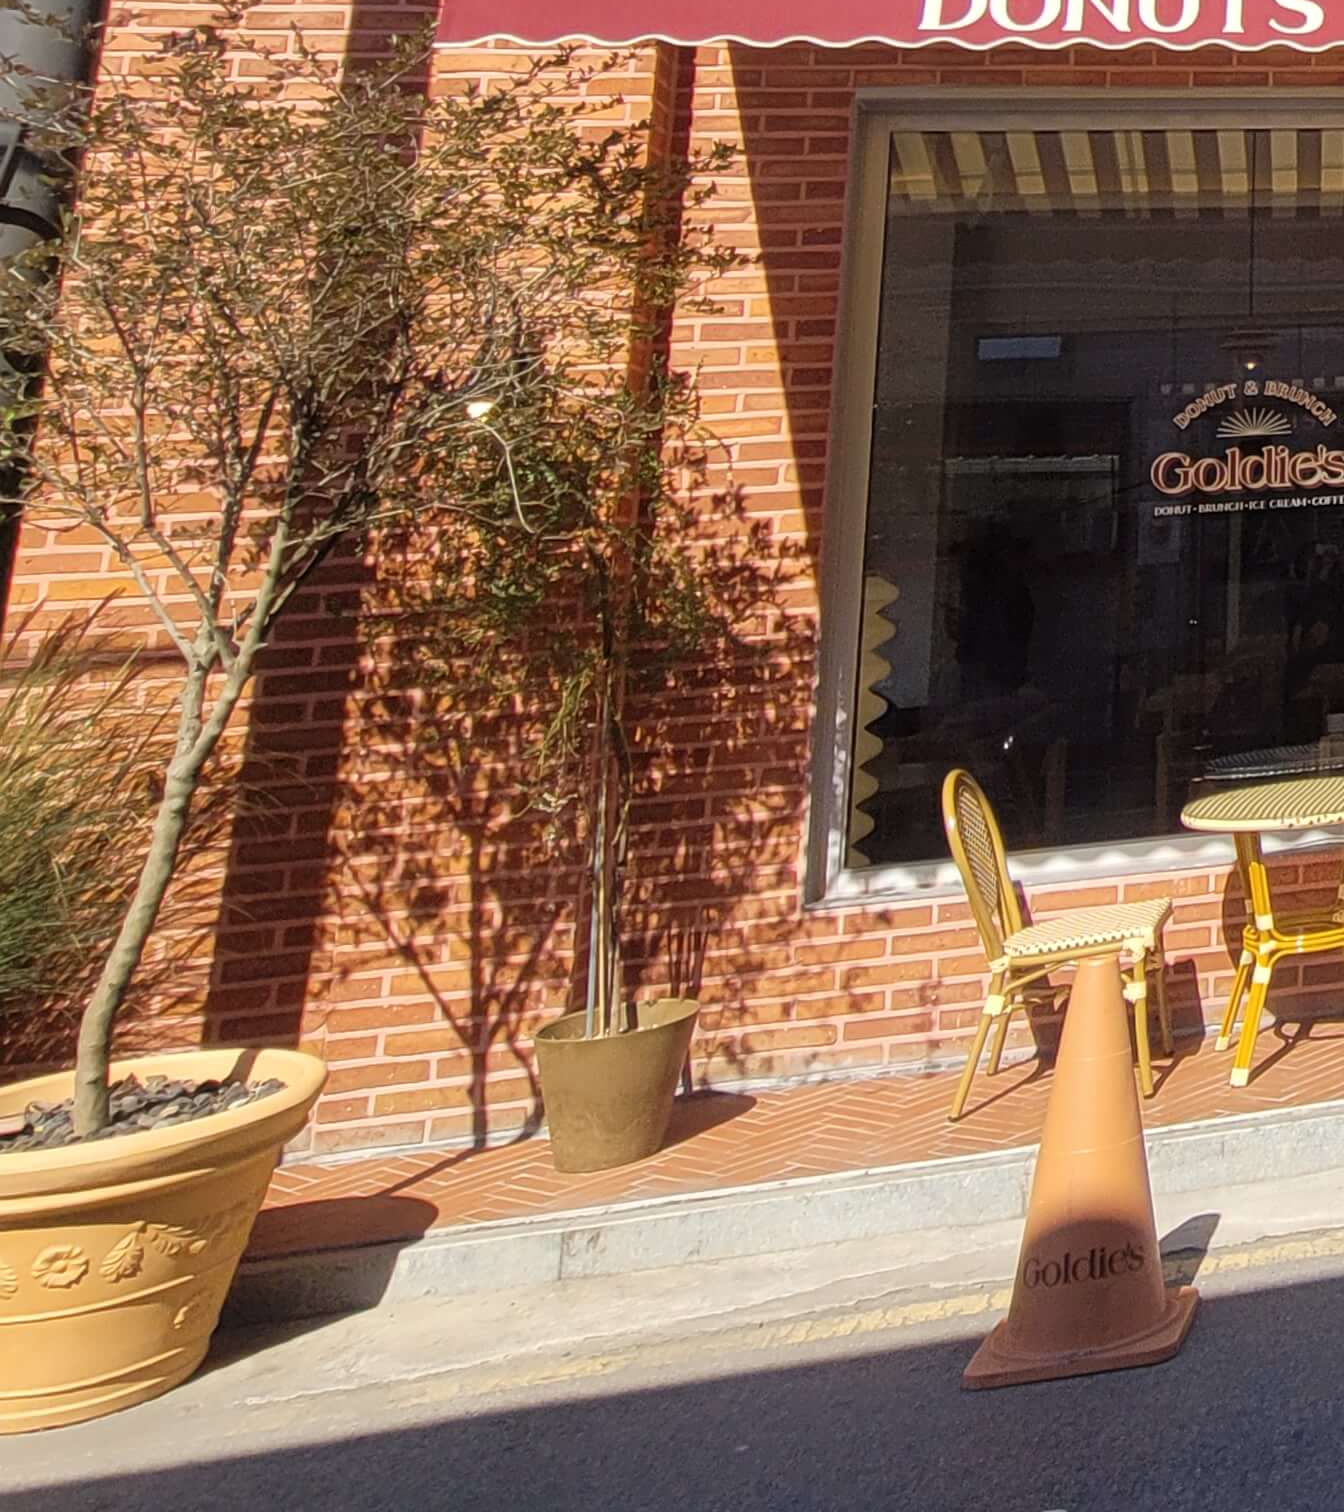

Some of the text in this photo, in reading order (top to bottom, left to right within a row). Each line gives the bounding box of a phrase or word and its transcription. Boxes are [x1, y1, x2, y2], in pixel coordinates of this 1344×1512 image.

[1172, 380, 1337, 430] DONUT & BRUNCH
[1022, 1240, 1145, 1288] Goldie's
